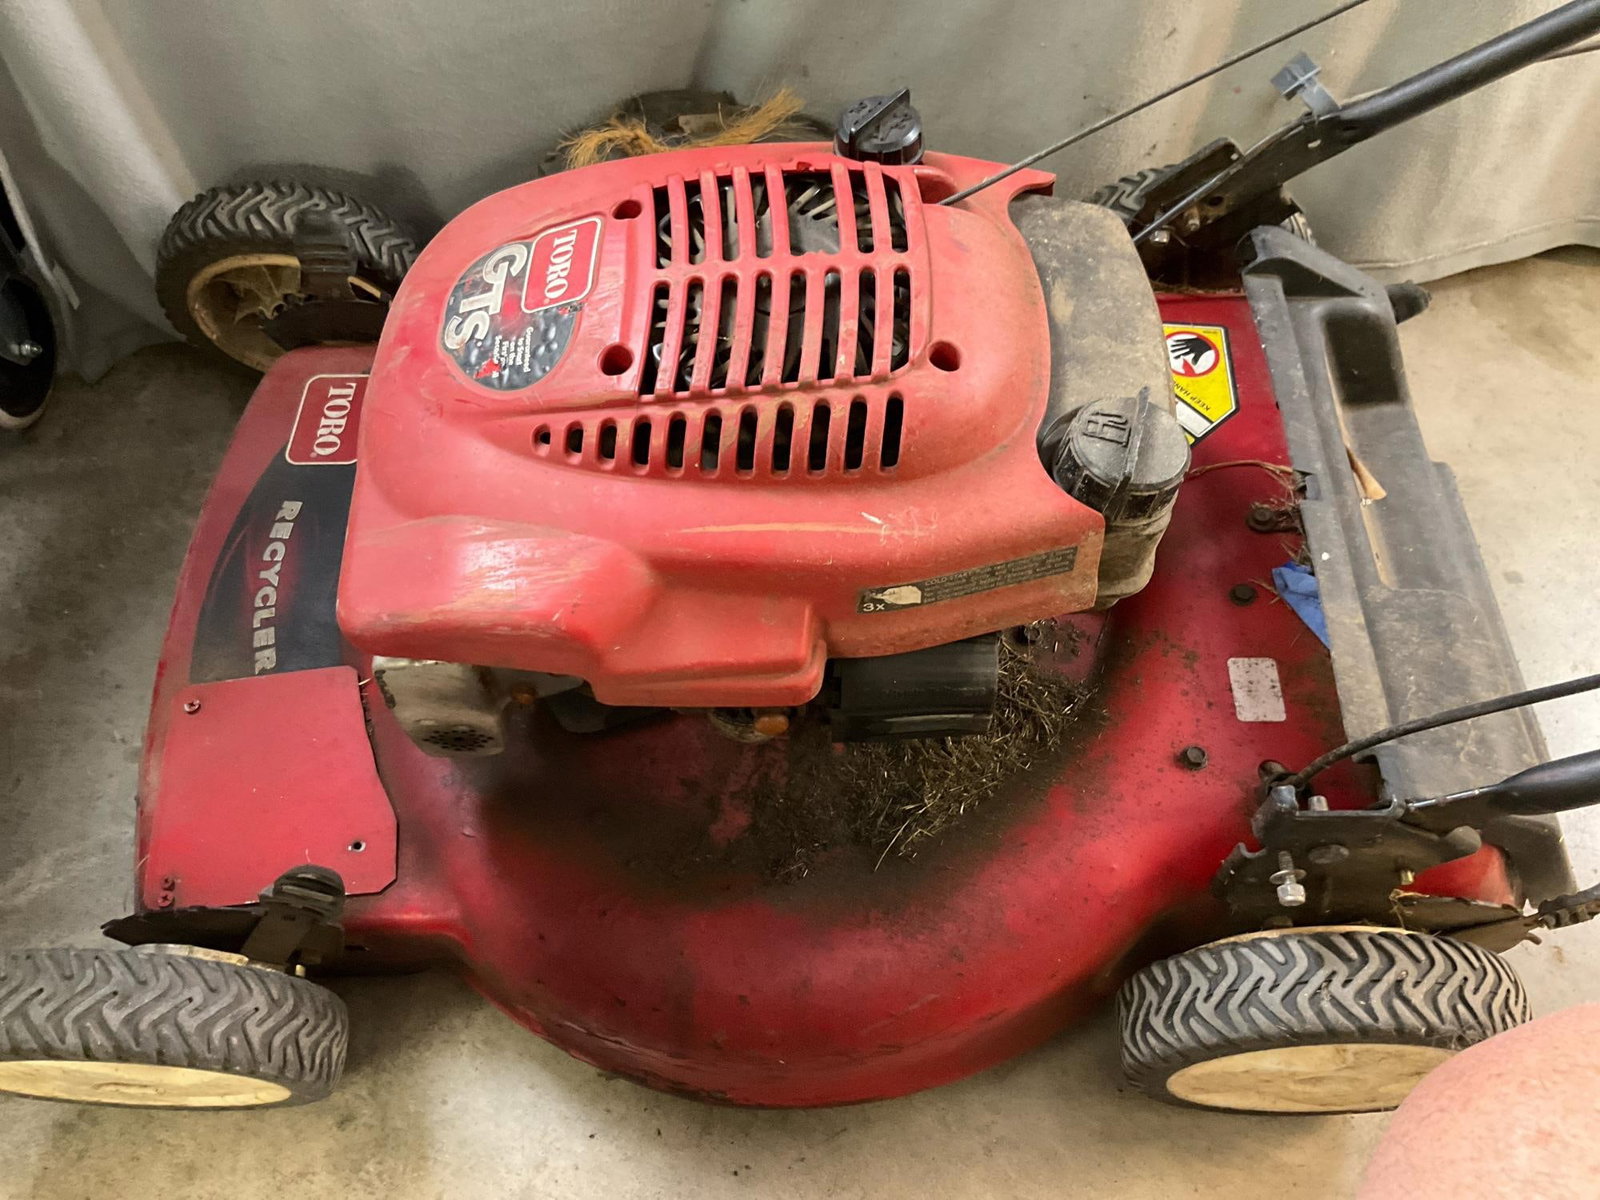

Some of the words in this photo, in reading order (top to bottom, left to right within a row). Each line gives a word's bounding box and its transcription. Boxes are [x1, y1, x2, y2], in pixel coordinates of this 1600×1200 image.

[444, 243, 528, 350] GTS
[545, 228, 578, 299] TORO
[523, 327, 533, 372] Guaranteed
[312, 382, 357, 457] TORO
[1173, 381, 1191, 398] HAN
[1190, 396, 1211, 412] KEEP
[252, 500, 304, 675] RECYCLER
